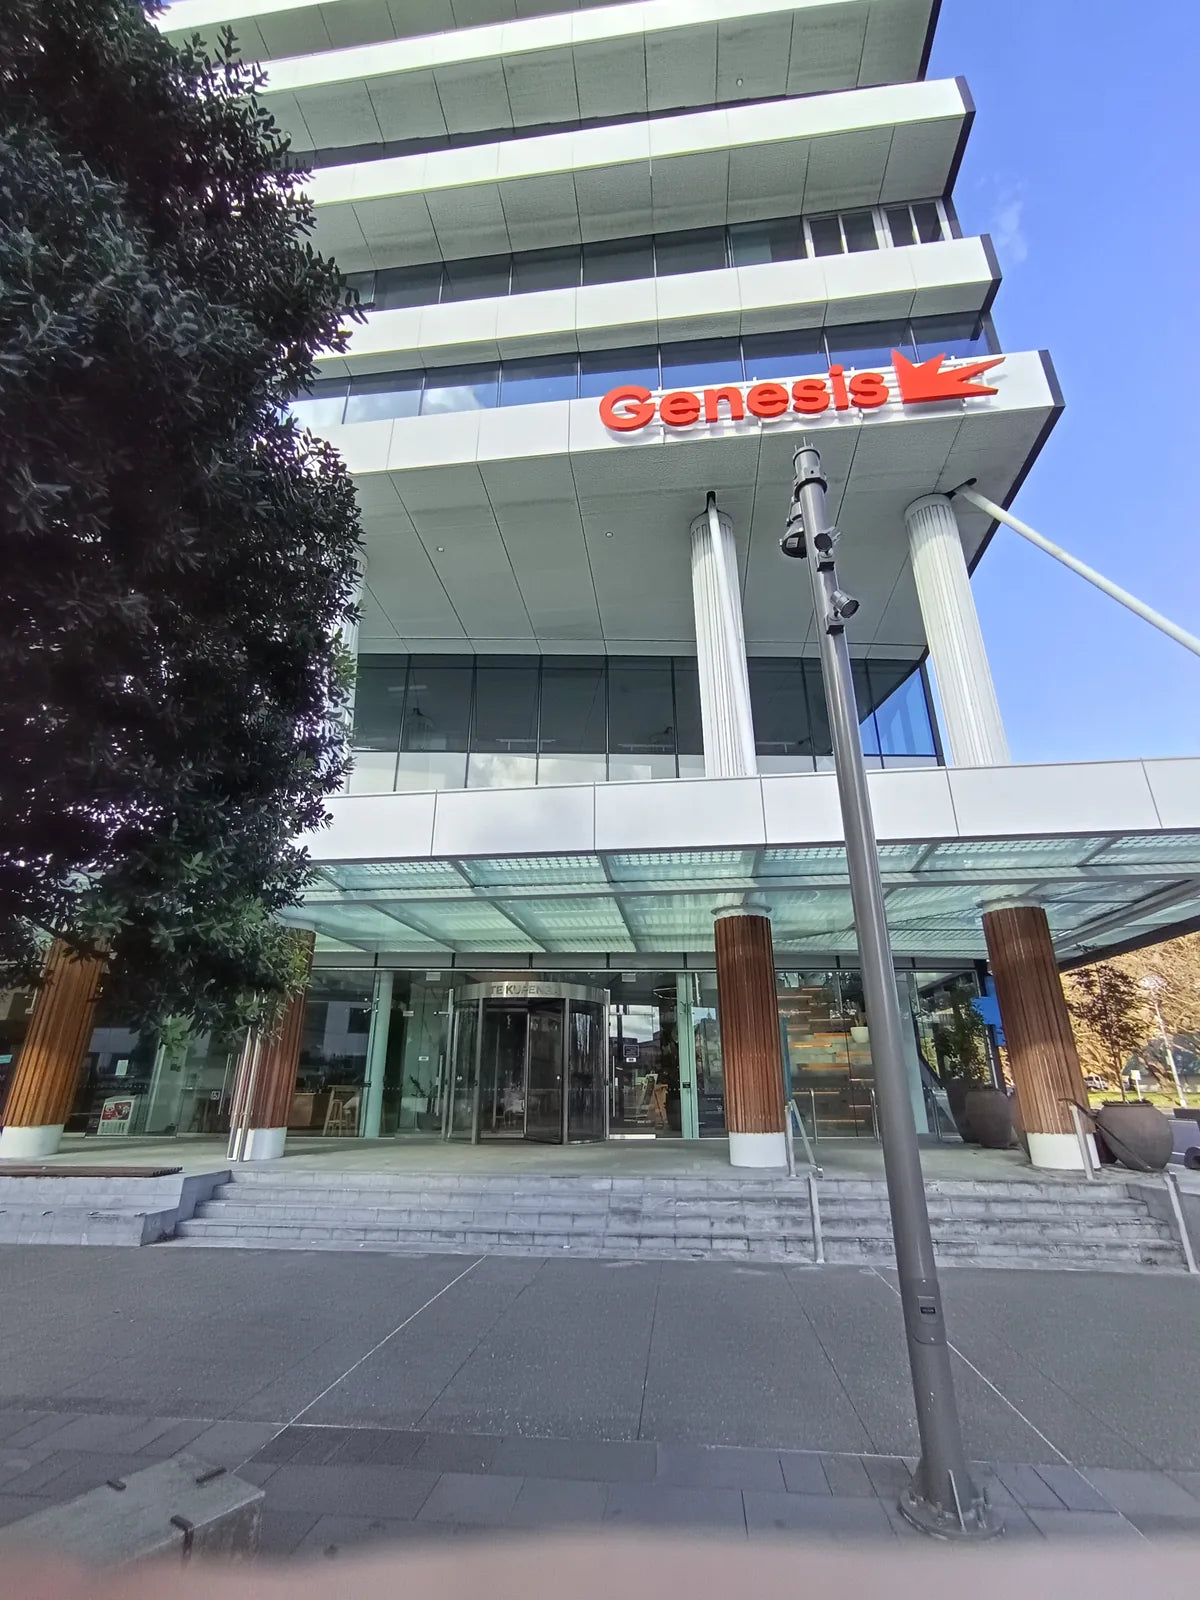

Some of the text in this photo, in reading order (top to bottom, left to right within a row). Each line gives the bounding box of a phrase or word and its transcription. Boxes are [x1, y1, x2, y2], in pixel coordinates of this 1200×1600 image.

[599, 364, 890, 432] Genesis
[489, 985, 560, 995] TE KUPEN
